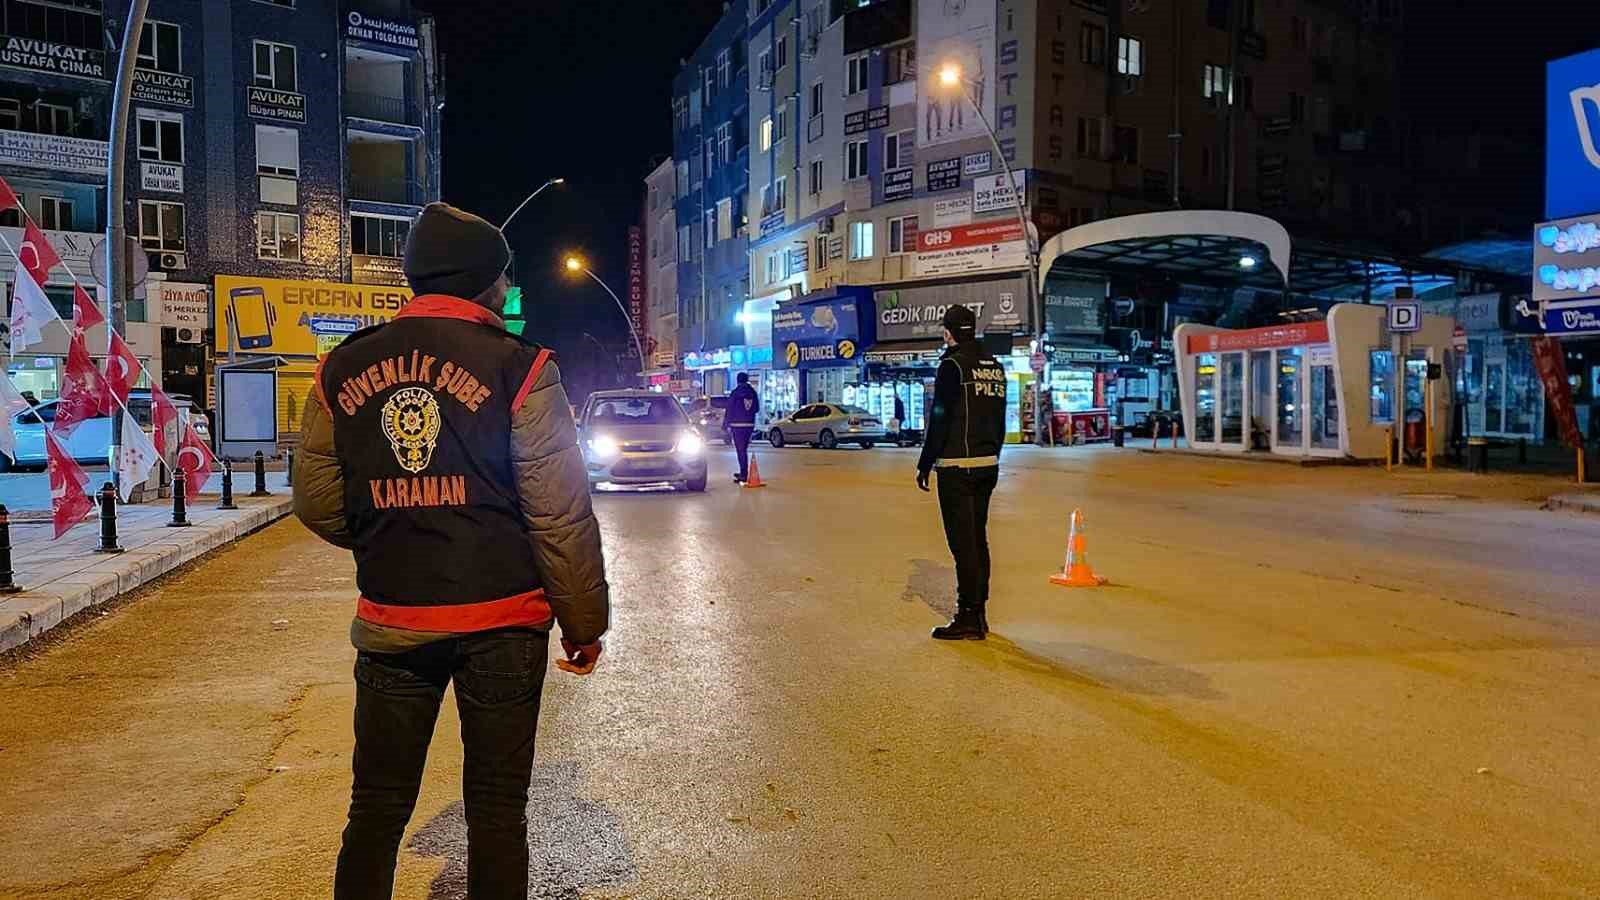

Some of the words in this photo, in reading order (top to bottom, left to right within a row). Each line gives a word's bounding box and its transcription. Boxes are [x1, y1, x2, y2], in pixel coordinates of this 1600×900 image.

[7, 38, 87, 61] AVUKAT
[60, 59, 103, 76] ÇINAR
[133, 71, 190, 89] AVUKAT
[250, 90, 303, 107] AVUKAT
[149, 164, 176, 176] AVUKAT
[924, 230, 952, 245] GH9
[164, 289, 183, 301] ZİYA
[283, 286, 362, 309] ERCAN
[881, 307, 921, 325] GEDİK
[1396, 308, 1411, 324] D
[337, 349, 437, 416] GÜVENLİK
[432, 360, 493, 414] ŞUBE
[369, 475, 466, 509] KARAMAN
